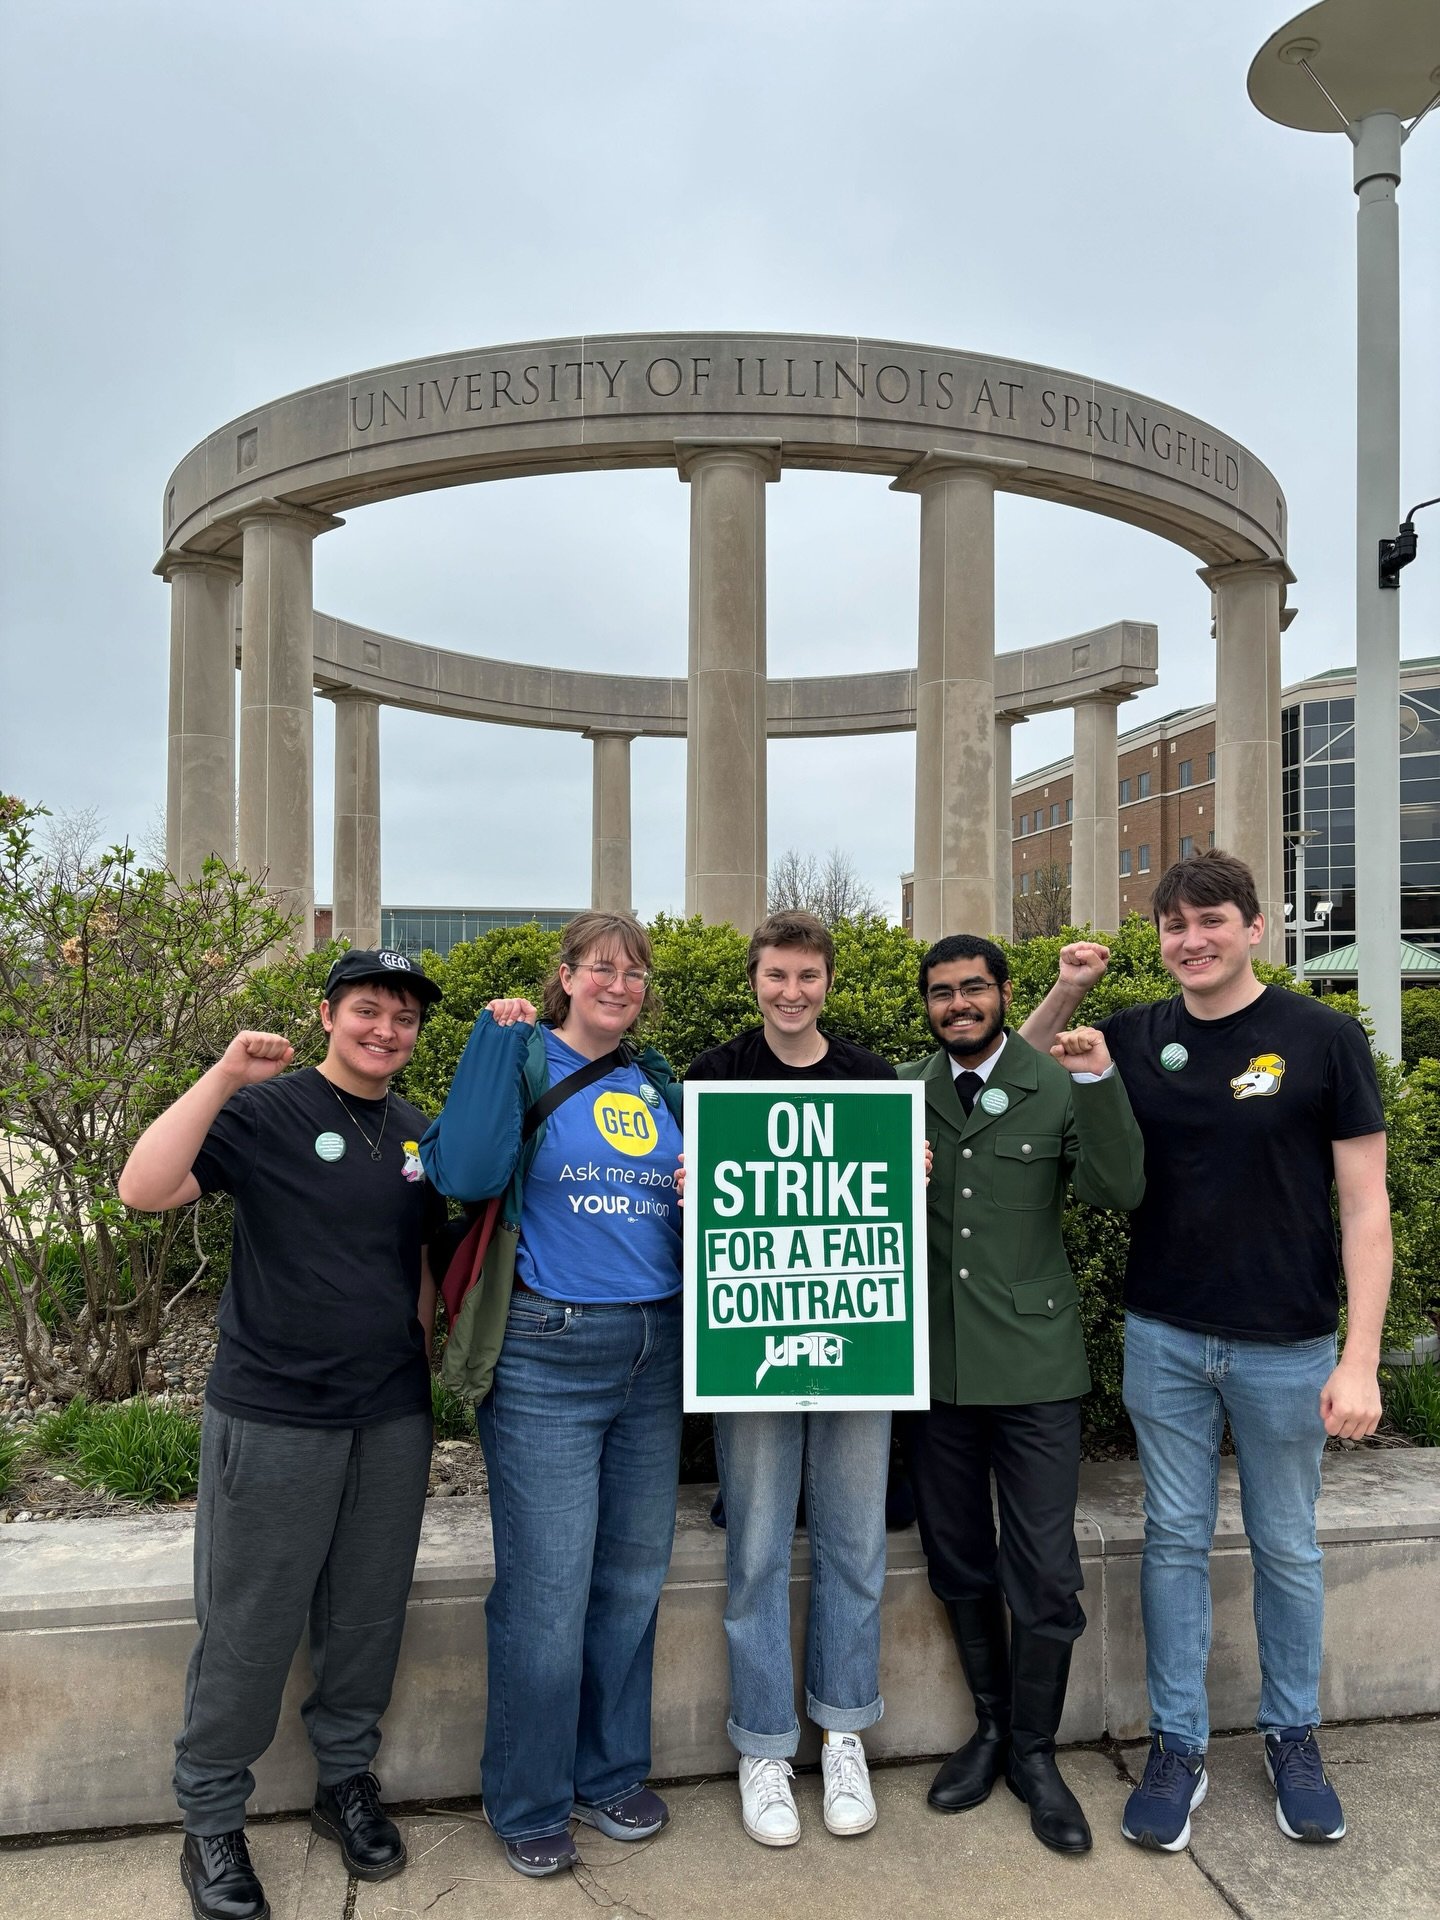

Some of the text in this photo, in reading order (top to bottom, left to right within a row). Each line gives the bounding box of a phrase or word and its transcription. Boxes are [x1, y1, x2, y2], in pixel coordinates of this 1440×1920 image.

[350, 357, 1240, 492] UNIVERSITY OF ILLINOIS AT SPRINGFIELD
[384, 954, 405, 968] GEO
[602, 1107, 650, 1140] GEO
[767, 1101, 834, 1158] ON
[559, 1161, 679, 1190] Ask me abou
[713, 1160, 889, 1218] STRIKE
[568, 1195, 670, 1217] YOUR union
[707, 1226, 901, 1272] FOR A FAIR
[712, 1277, 900, 1324] CONTRACT
